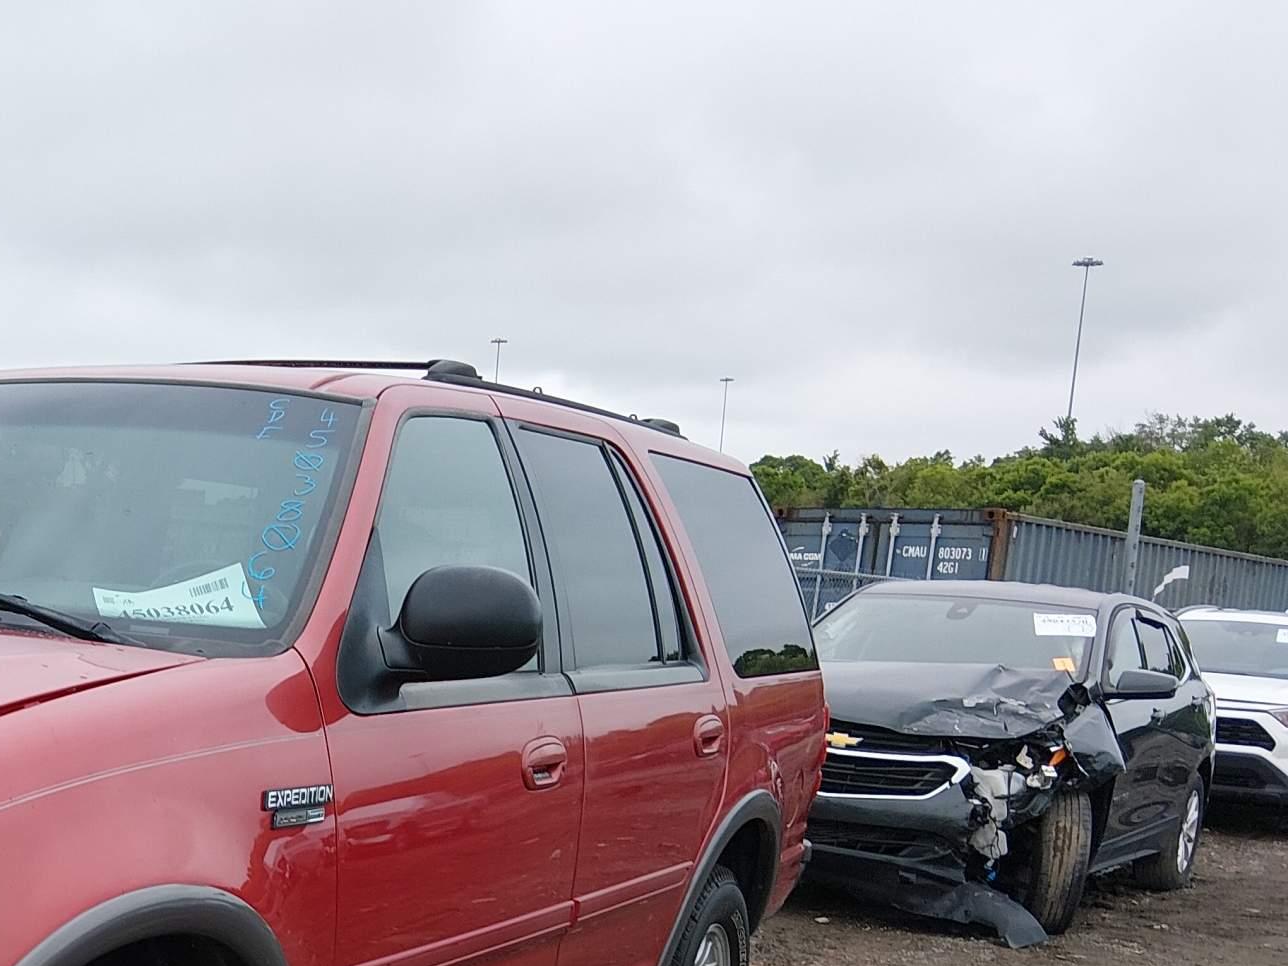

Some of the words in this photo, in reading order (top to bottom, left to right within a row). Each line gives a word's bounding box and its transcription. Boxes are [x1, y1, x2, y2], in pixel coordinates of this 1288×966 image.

[902, 546, 927, 558] CMAU
[938, 547, 972, 560] 803073
[119, 596, 234, 619] 45038064
[268, 785, 333, 809] EXPEDITION
